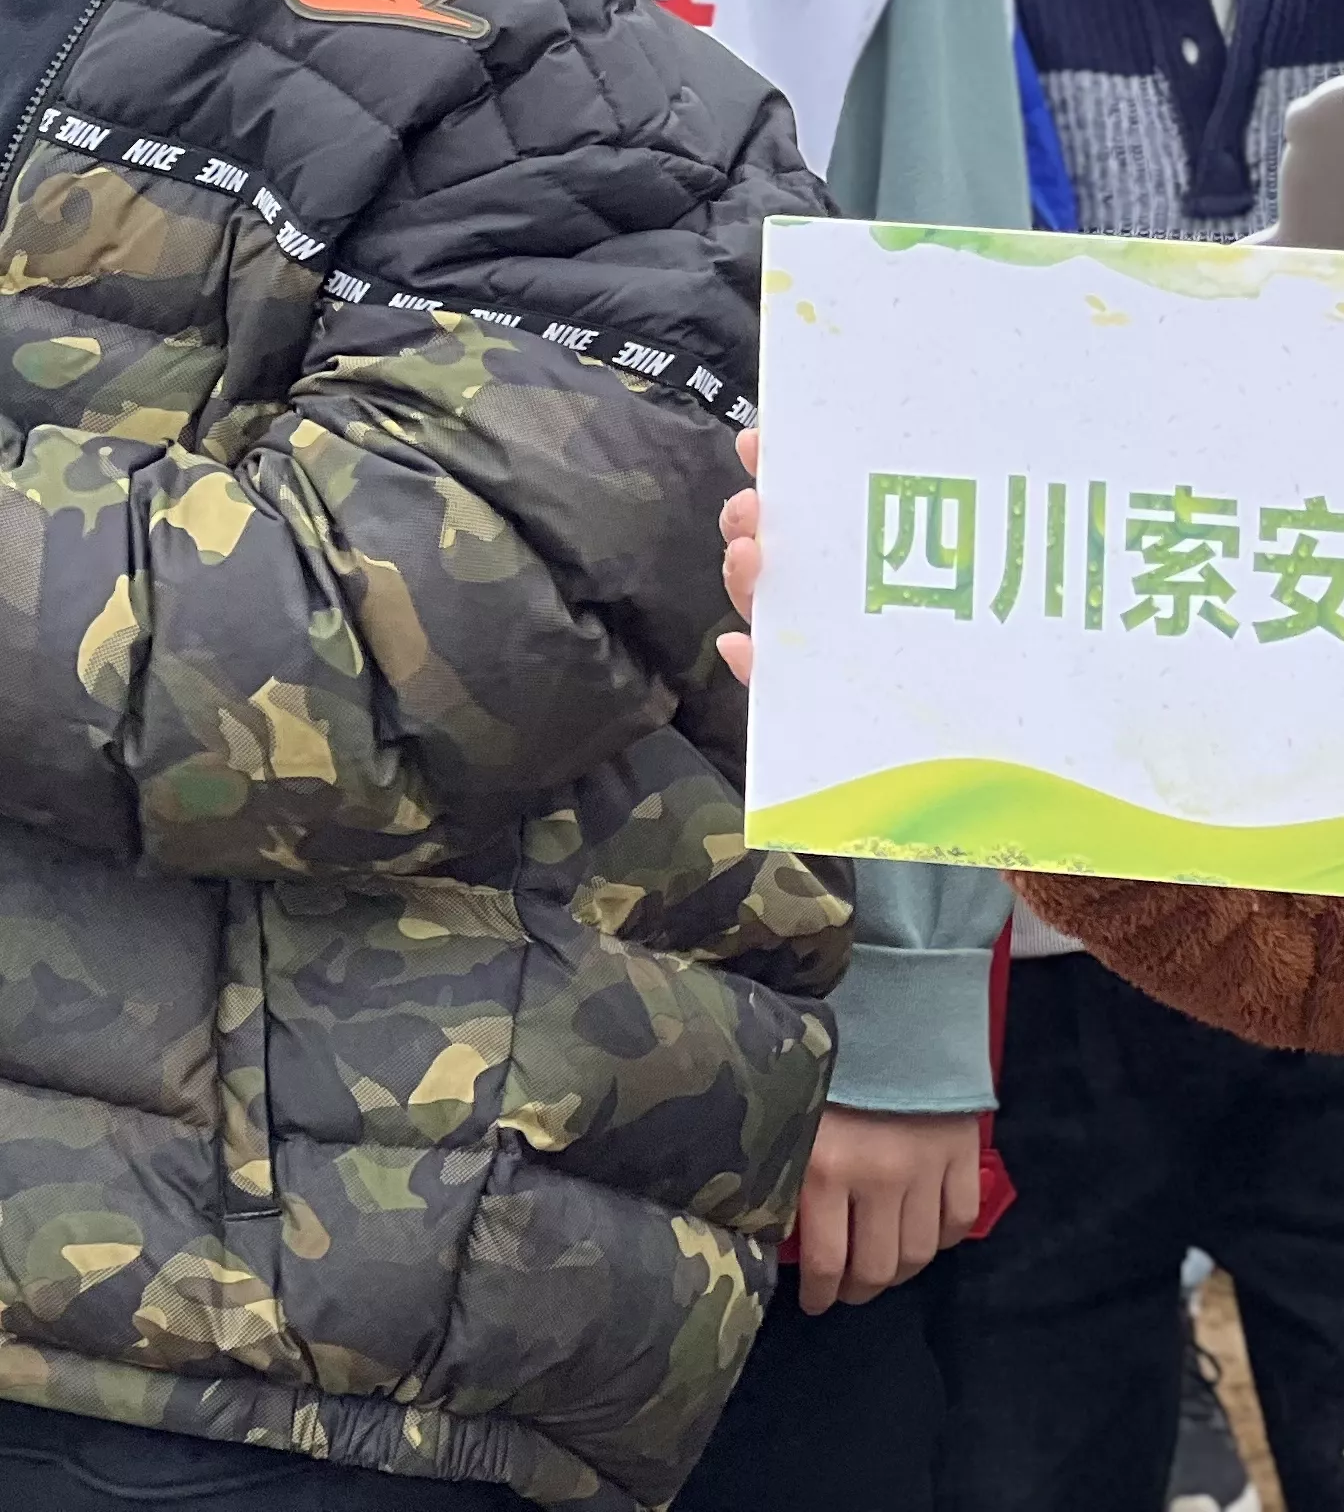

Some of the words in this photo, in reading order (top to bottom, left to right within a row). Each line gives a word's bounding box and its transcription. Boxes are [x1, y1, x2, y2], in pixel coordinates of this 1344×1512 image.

[55, 116, 111, 151] NIKE
[122, 138, 186, 171] NIKE
[195, 157, 249, 193] NIKE
[252, 186, 282, 225] NIKE
[275, 220, 326, 261] NIKE
[542, 322, 600, 351] NIKE
[611, 341, 675, 377] NIKE
[686, 365, 724, 403] NIKE
